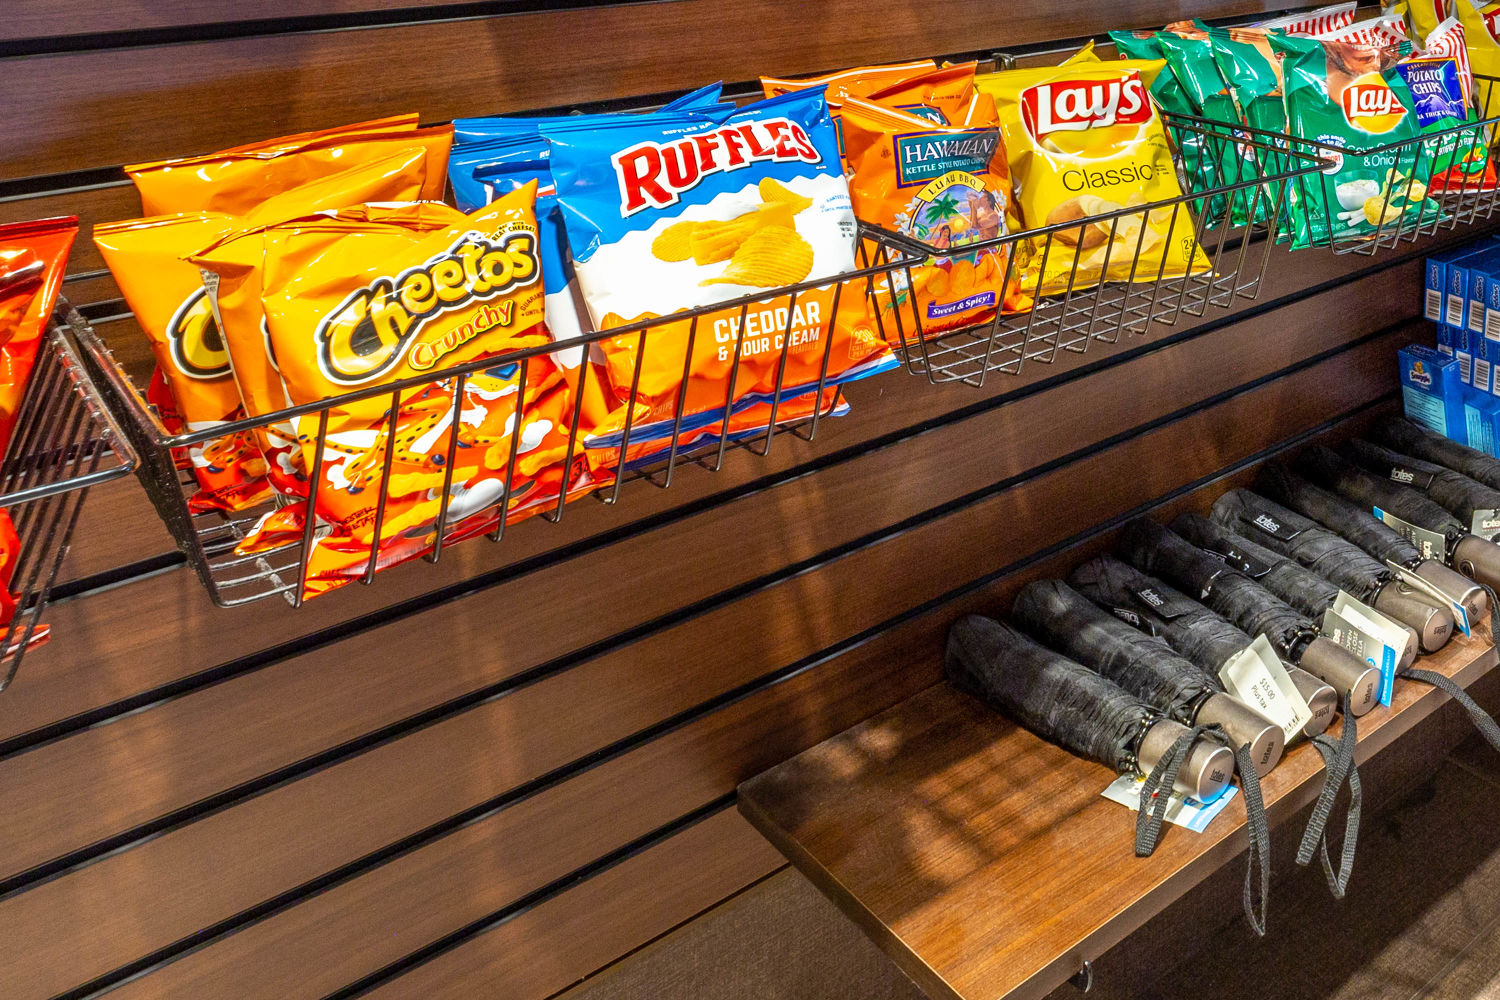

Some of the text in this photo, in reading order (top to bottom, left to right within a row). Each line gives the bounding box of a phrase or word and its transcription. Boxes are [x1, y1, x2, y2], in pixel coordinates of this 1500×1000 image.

[1406, 69, 1442, 83] POTATO
[1412, 82, 1442, 95] CHIPS
[1036, 75, 1143, 136] Lay's
[904, 138, 990, 164] HAWAIIAN
[1363, 157, 1371, 167] &
[618, 120, 819, 212] RUFFLES
[906, 163, 936, 175] KETTLE
[1062, 161, 1153, 192] Classic
[928, 172, 977, 196] LUAU BBQ
[326, 237, 535, 377] Cheetos
[931, 293, 991, 316] Sweet & Spicy!
[409, 299, 514, 367] Crunchy
[713, 301, 821, 344] CHEDDAR
[854, 329, 874, 344] 230
[718, 345, 728, 361] &
[738, 338, 770, 357] OUR
[1390, 467, 1415, 483] totes
[1256, 514, 1281, 533] totes
[1141, 588, 1164, 607] totes
[1251, 684, 1268, 710] Plus tax
[1259, 677, 1276, 700] $15.00
[1261, 741, 1275, 766] totes
